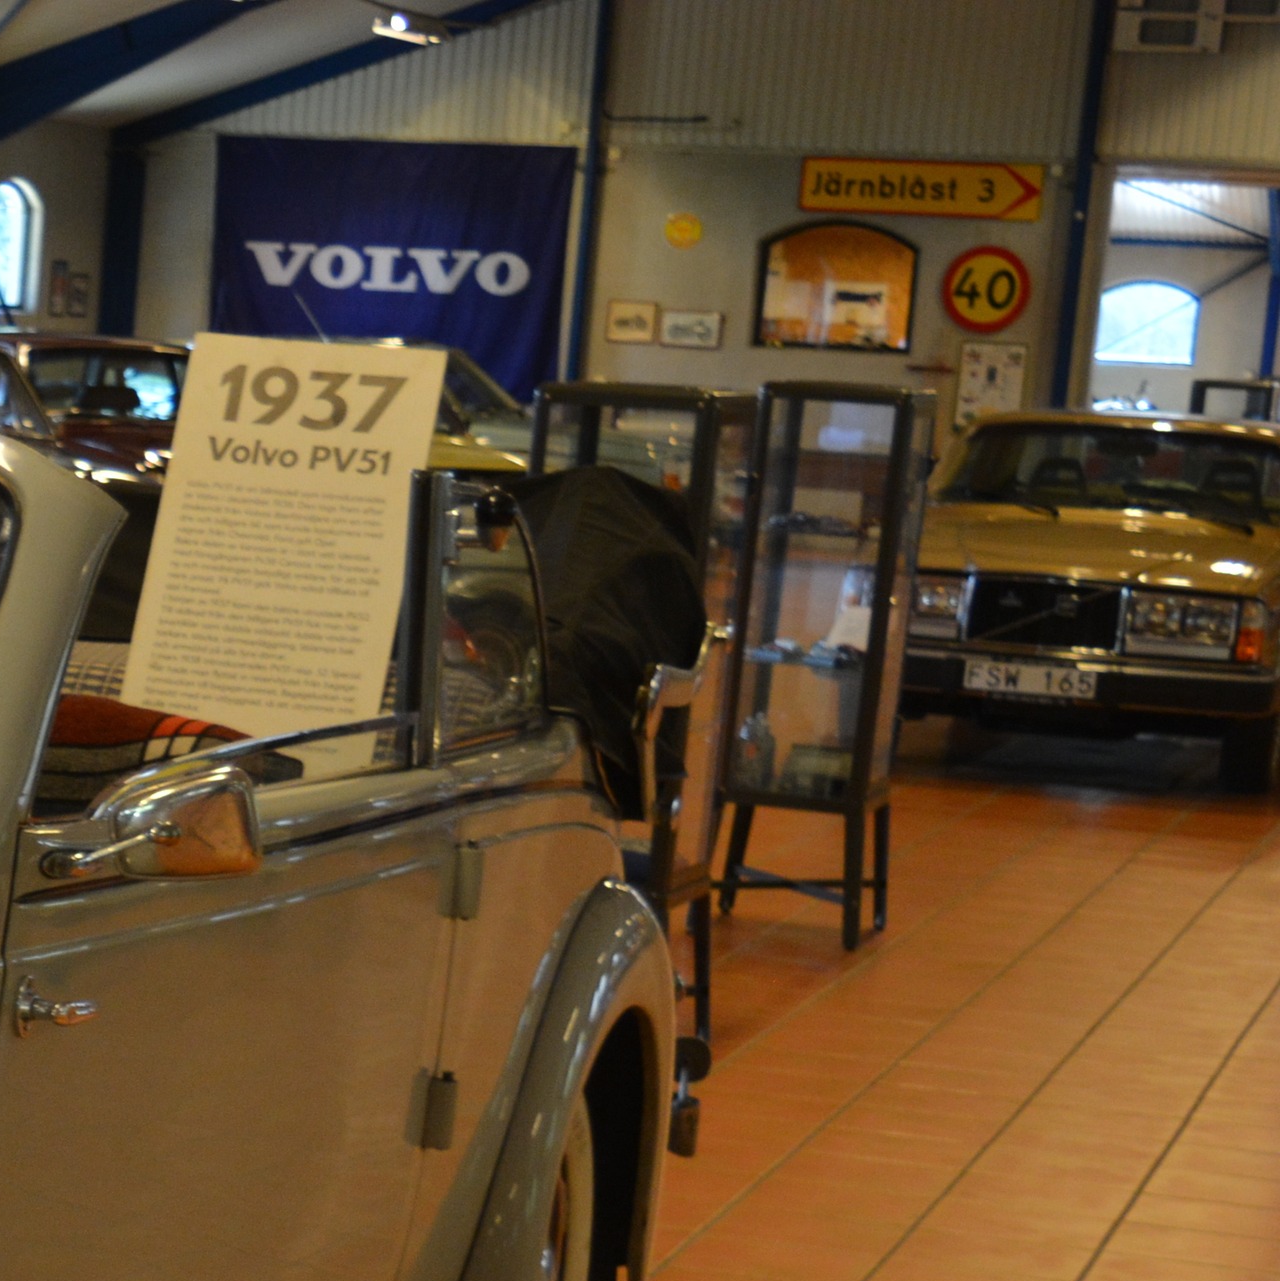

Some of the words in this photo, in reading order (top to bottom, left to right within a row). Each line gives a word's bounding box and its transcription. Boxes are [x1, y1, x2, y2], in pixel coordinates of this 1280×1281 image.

[811, 171, 957, 202] Järnblåst
[976, 178, 996, 203] 3
[245, 240, 531, 297] VOLVO
[953, 267, 1017, 311] 40
[218, 364, 409, 434] 1937
[208, 436, 299, 470] Volvo
[309, 445, 392, 476] PV51
[967, 661, 1020, 688] FSW
[1044, 668, 1092, 695] 165
